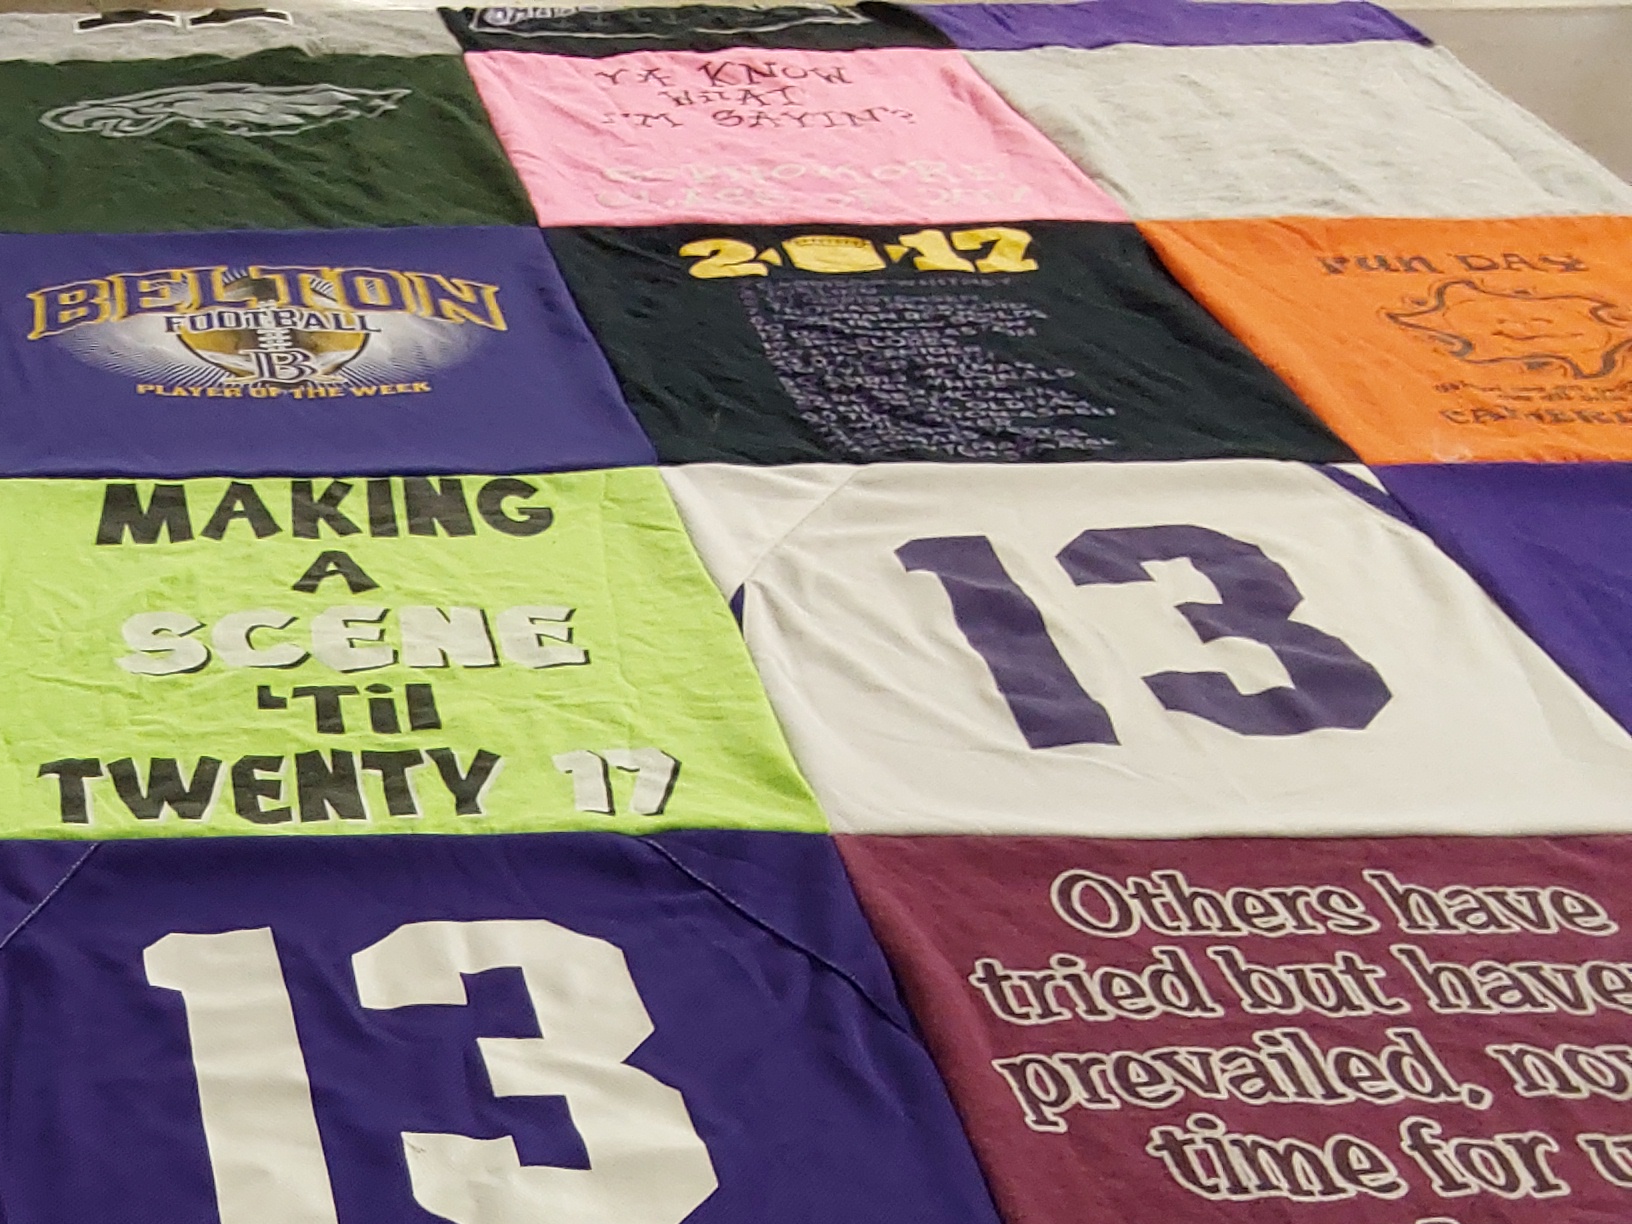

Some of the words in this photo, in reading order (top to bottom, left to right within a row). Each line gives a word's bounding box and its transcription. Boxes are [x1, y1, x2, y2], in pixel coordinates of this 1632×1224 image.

[595, 66, 675, 86] YA
[698, 60, 853, 88] KNOW
[658, 85, 805, 107] WHAT
[1448, 252, 1590, 273] DAY
[25, 264, 509, 341] BELTON
[164, 307, 382, 334] FOOTBALL
[136, 383, 243, 398] PLAYER
[249, 386, 287, 399] OF
[289, 385, 345, 400] THE
[349, 381, 432, 398] WEEK
[94, 476, 555, 547] MAKING
[291, 549, 381, 595] A
[116, 603, 591, 676] SCENE
[893, 524, 1394, 750] 13
[36, 747, 503, 825] TWENTY
[552, 745, 682, 817] 17
[1049, 869, 1381, 937] Others
[1363, 869, 1619, 935] have
[969, 944, 1225, 1026] tried
[1207, 945, 1413, 1018] but
[992, 1027, 1494, 1135] prevailed.
[1486, 1043, 1632, 1101] no
[1145, 1112, 1409, 1202] time
[1400, 1115, 1571, 1199] for
